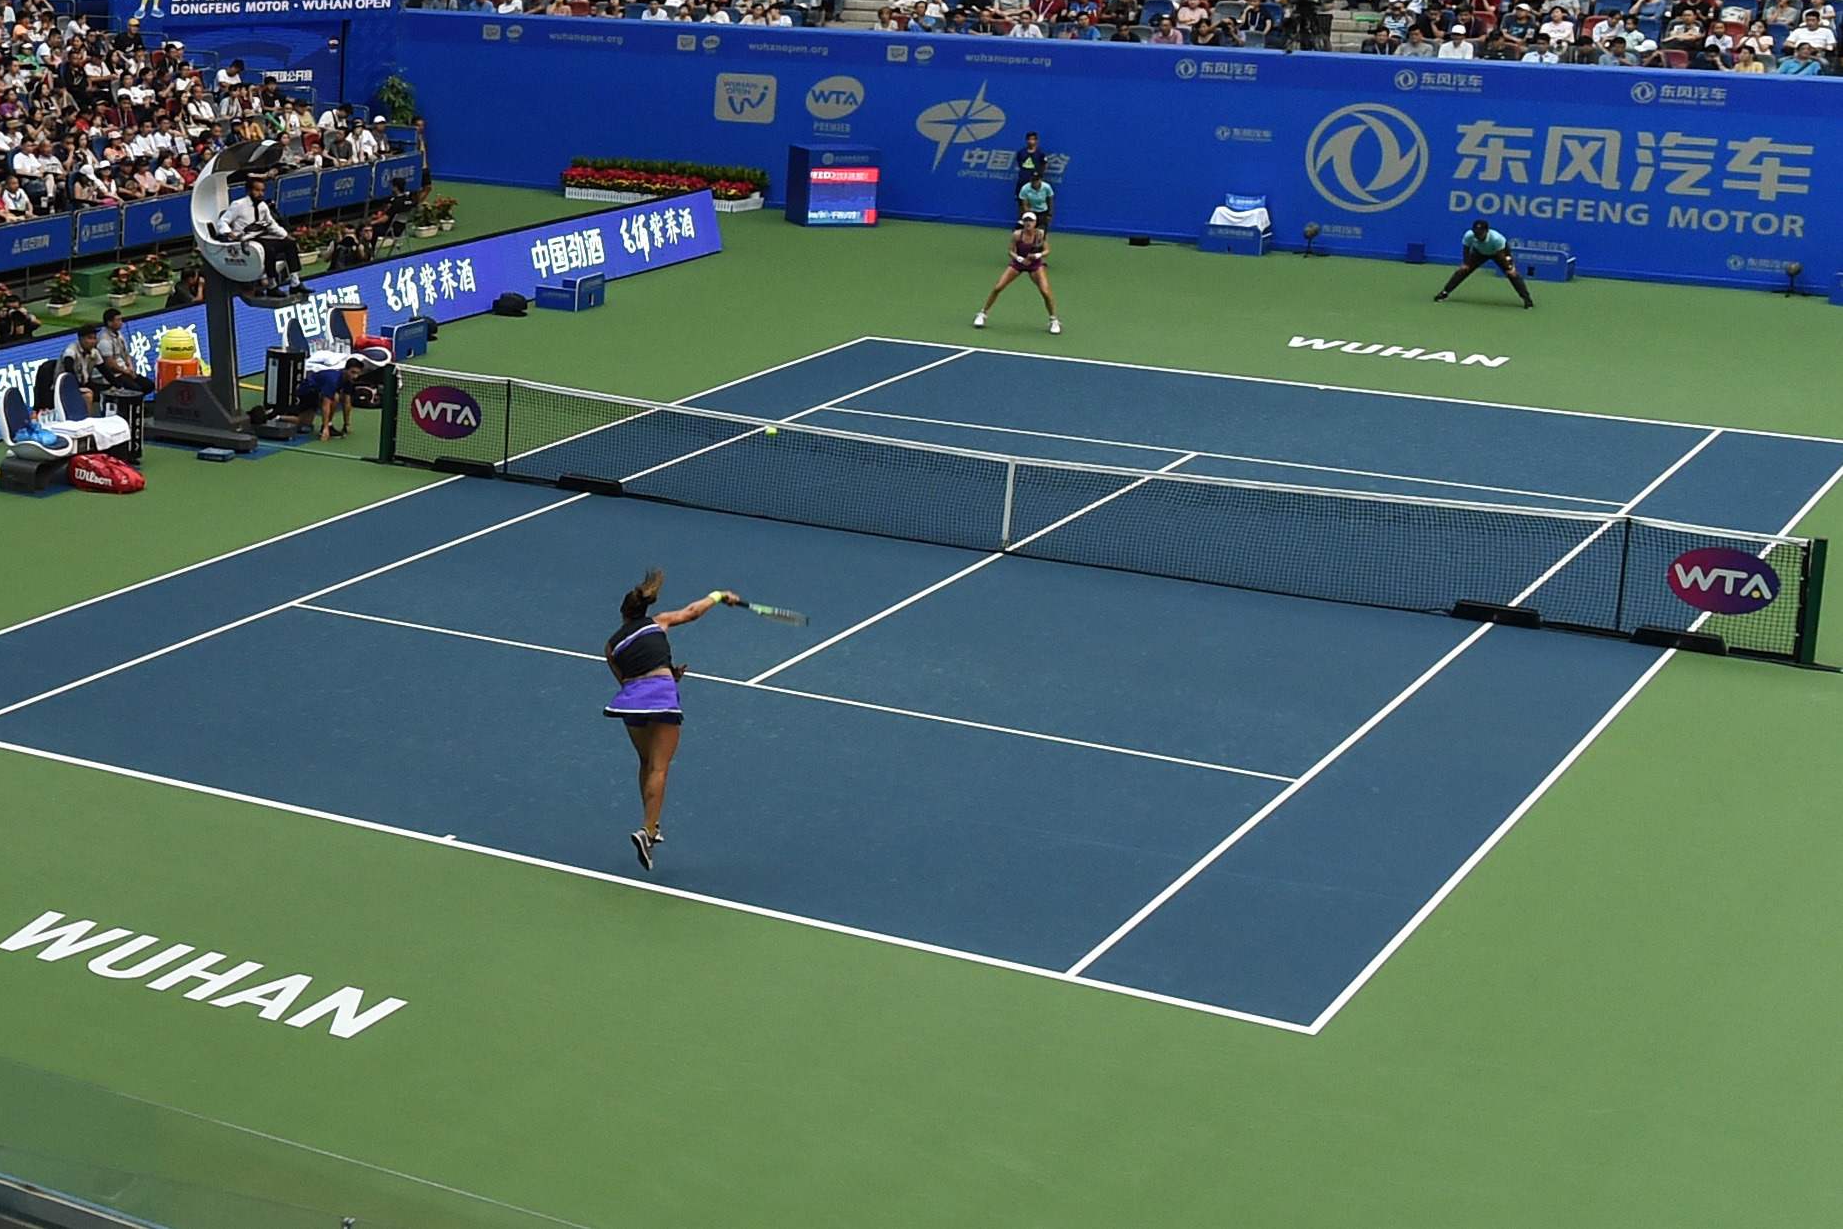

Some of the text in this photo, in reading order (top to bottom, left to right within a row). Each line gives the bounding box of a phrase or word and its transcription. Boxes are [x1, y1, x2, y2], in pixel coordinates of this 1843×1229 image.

[170, 2, 240, 15] DONGFENG
[244, 1, 289, 12] MOTOR
[302, 0, 353, 11] WUHAN
[549, 32, 624, 46] wuhanopen.org
[748, 42, 829, 57] wuhanopen.org
[965, 52, 1052, 68] wuhanopen.org
[1200, 61, 1258, 76] 东风汽车
[1420, 72, 1484, 88] 东风汽车
[811, 89, 858, 106] WTA
[1659, 85, 1728, 100] 东风汽车
[962, 147, 1070, 175] 中国谷
[1451, 120, 1814, 202] 东风汽车
[1449, 190, 1805, 238] DONGFENG MOTOR
[531, 228, 605, 278] 中国劲酒
[165, 345, 194, 353] HEAD
[1288, 336, 1510, 368] WUHAN
[414, 398, 478, 428] WTA
[73, 466, 113, 486] Wilson
[1674, 562, 1773, 600] WTA
